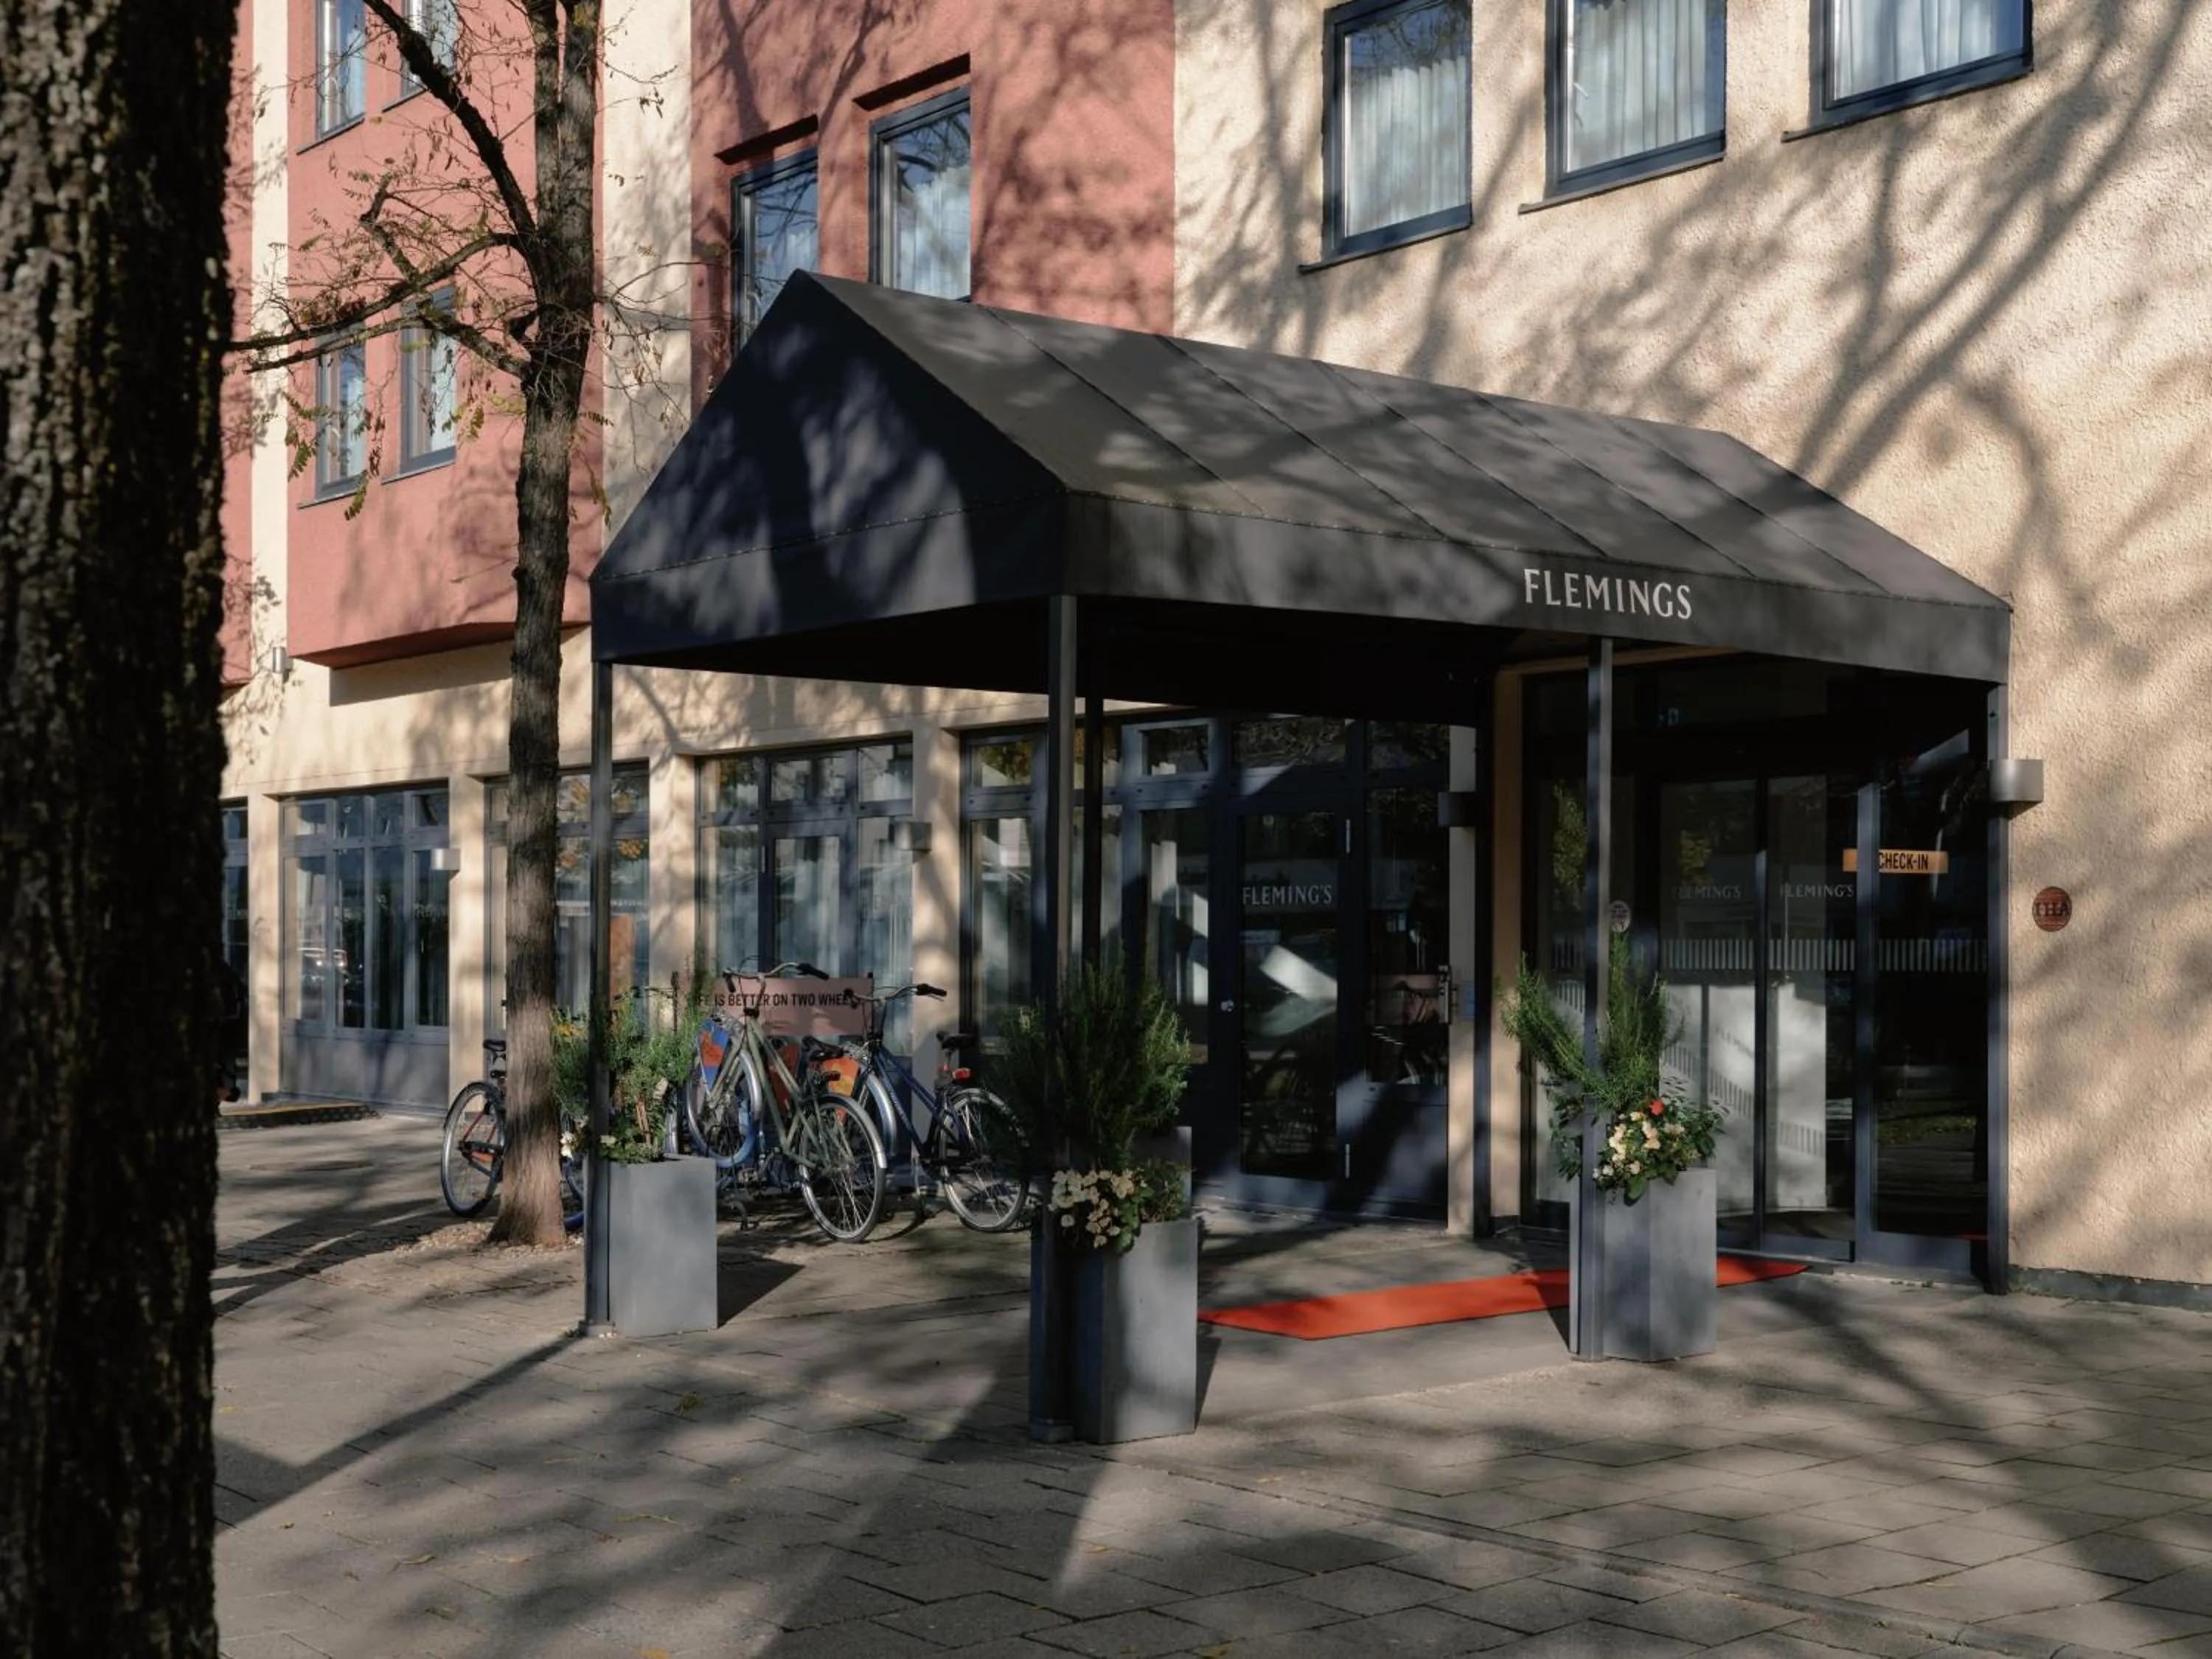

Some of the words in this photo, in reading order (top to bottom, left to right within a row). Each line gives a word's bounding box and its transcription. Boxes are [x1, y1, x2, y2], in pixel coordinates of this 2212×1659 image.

[1524, 568, 1692, 619] FLEMINGS
[1878, 852, 1929, 870] CHECK-IN
[1242, 884, 1332, 905] FLEMING'S
[714, 994, 725, 1006] IS
[773, 993, 787, 1006] ON
[792, 993, 815, 1007] TWO
[818, 993, 860, 1006] WHEE
